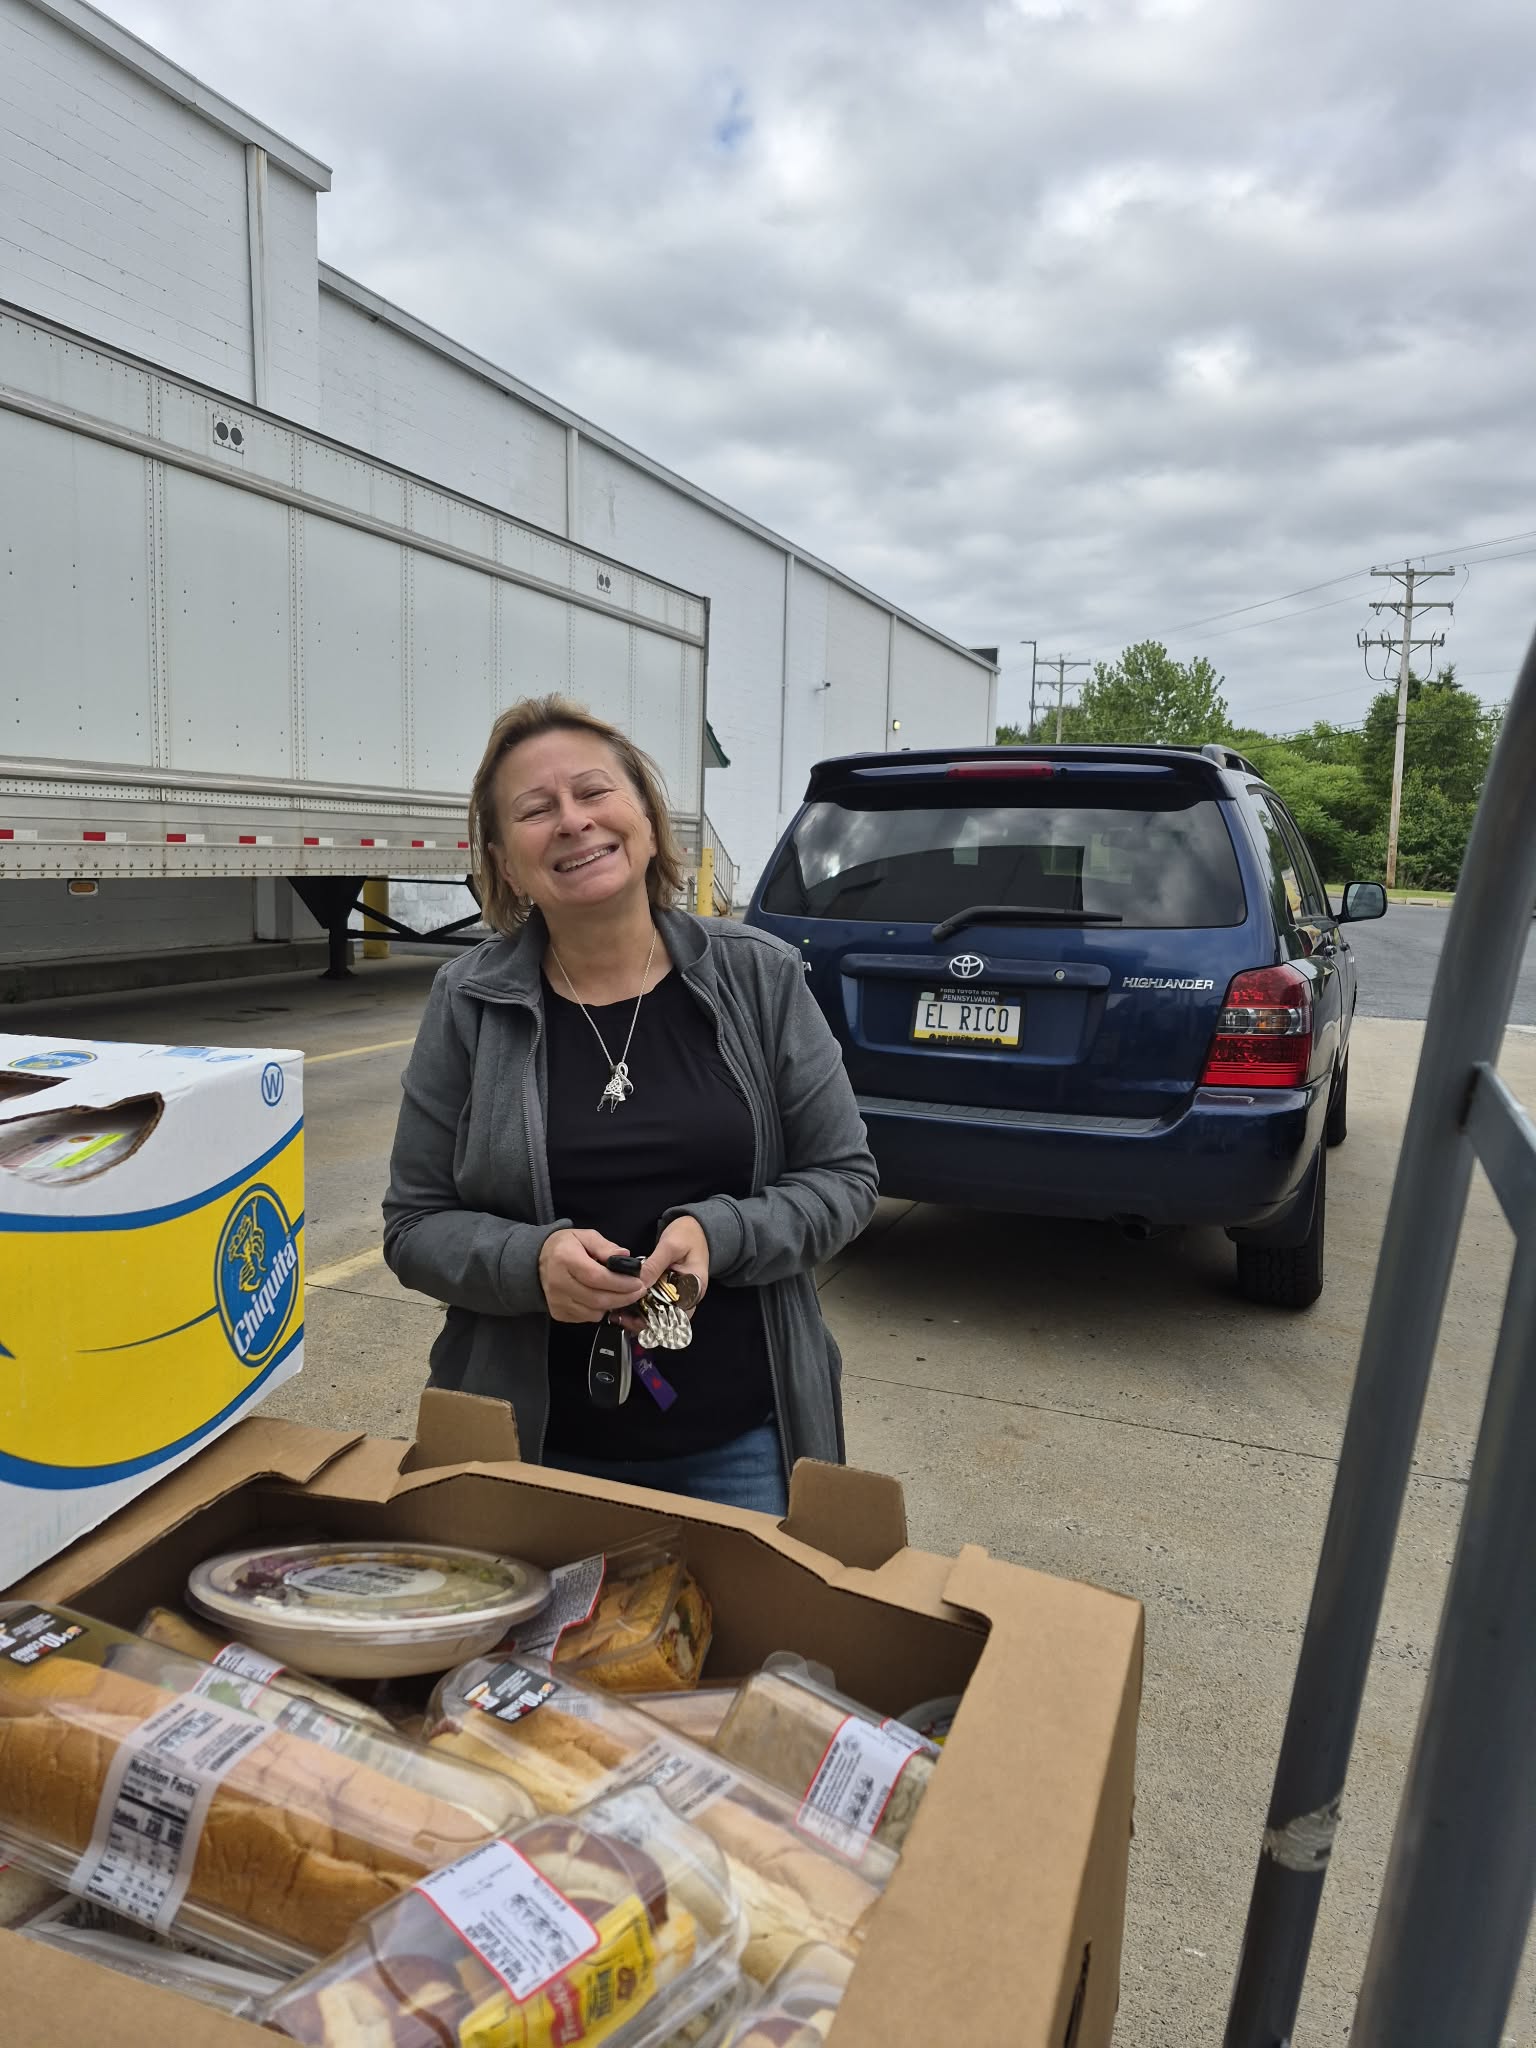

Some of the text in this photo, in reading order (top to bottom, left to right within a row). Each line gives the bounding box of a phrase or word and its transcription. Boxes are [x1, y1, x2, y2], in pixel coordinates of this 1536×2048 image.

[1122, 976, 1214, 990] HIGHLANDER
[942, 994, 996, 1004] PENNSYLVANIA
[925, 1003, 1010, 1033] EL RICO
[264, 1071, 282, 1100] W
[233, 1242, 298, 1357] Chiquita
[129, 1759, 169, 1785] Nutrition
[170, 1776, 195, 1797] Facts
